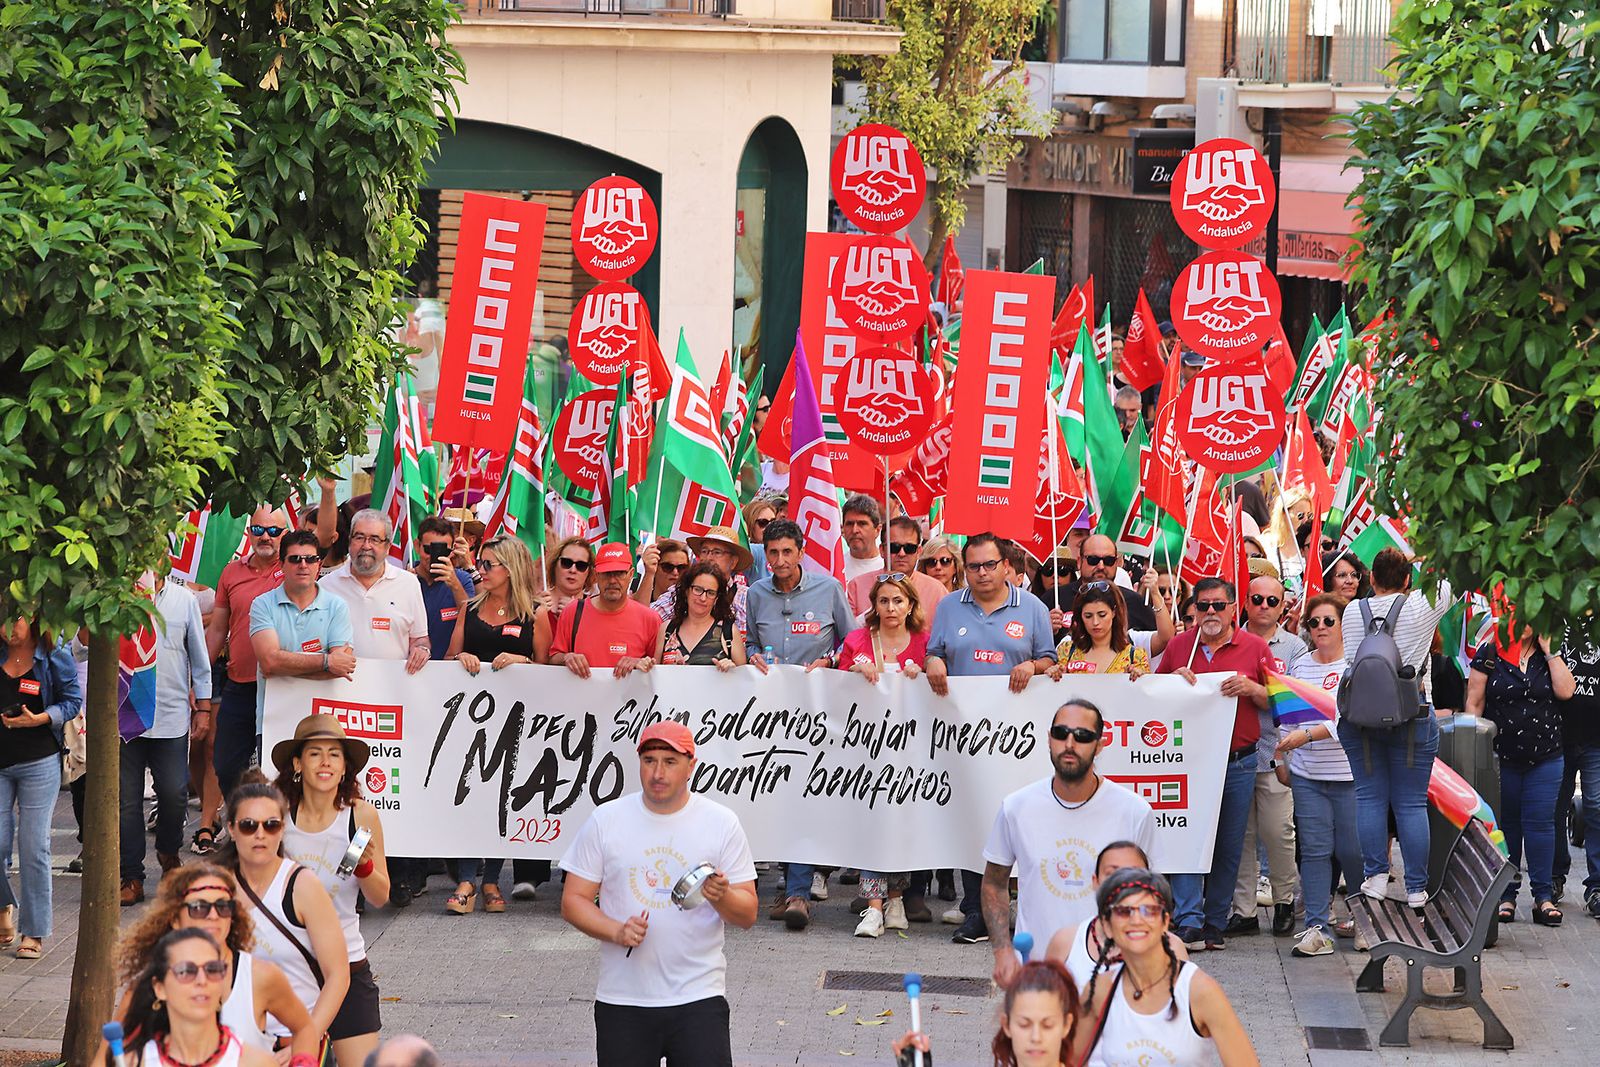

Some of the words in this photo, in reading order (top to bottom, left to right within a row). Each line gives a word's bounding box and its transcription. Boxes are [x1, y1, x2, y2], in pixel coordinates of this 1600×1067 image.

[844, 135, 909, 174] UGT
[1186, 149, 1256, 192] UGT
[583, 188, 643, 222] UGT
[855, 206, 905, 222] Andalucía
[1198, 220, 1253, 238] Andalucía
[589, 254, 636, 270] Andalucía
[845, 246, 913, 287] UGT
[1186, 261, 1263, 302] UGT
[581, 292, 640, 330] UGT
[855, 315, 907, 333] Andalucía
[1199, 332, 1258, 349] Andalucía
[587, 358, 631, 375] Andalucía
[848, 358, 917, 400] UGT
[1191, 375, 1267, 418] UGT
[459, 408, 491, 422] HUELVA
[570, 399, 634, 437] UG
[857, 427, 911, 444] Andalucía
[829, 451, 849, 461] ELVA
[1203, 445, 1262, 461] Andalucía
[976, 494, 1010, 506] HUELVA
[792, 624, 810, 632] UGT
[974, 650, 993, 661] UGT
[1068, 661, 1086, 670] UGT
[527, 713, 562, 740] DE
[841, 702, 916, 760] bajar
[930, 716, 1037, 760] precios
[1101, 721, 1135, 747] GT
[1130, 750, 1184, 764] Huelva
[454, 701, 625, 838] MAYO
[803, 751, 953, 810] beneficios
[510, 817, 561, 843] 2023
